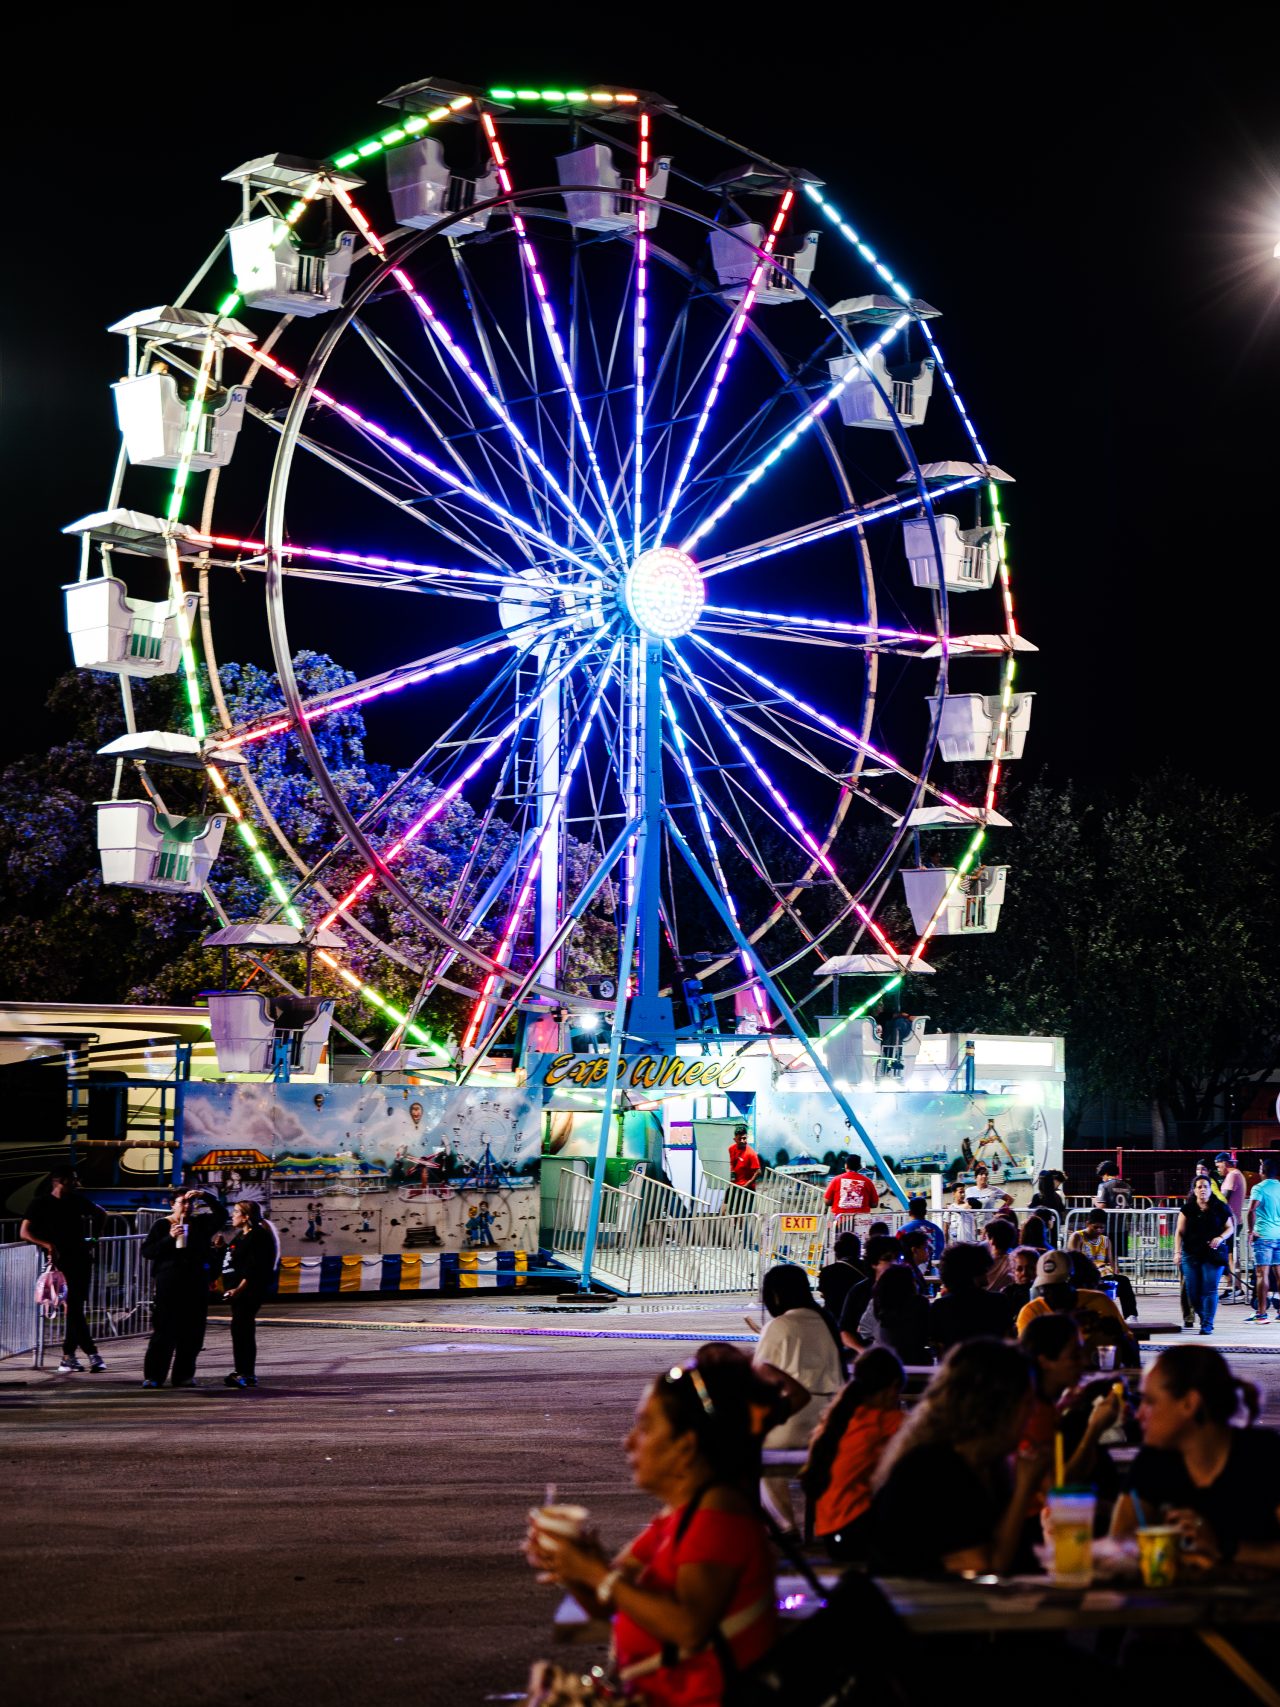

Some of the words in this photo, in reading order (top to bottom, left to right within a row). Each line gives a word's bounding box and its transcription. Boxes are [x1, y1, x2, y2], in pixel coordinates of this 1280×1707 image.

[215, 820, 221, 828] 8
[544, 1053, 627, 1088] Expo
[630, 1055, 745, 1089] Wheel
[637, 1166, 643, 1174] 5
[1115, 1193, 1126, 1209] 9
[785, 1217, 812, 1229] EXIT
